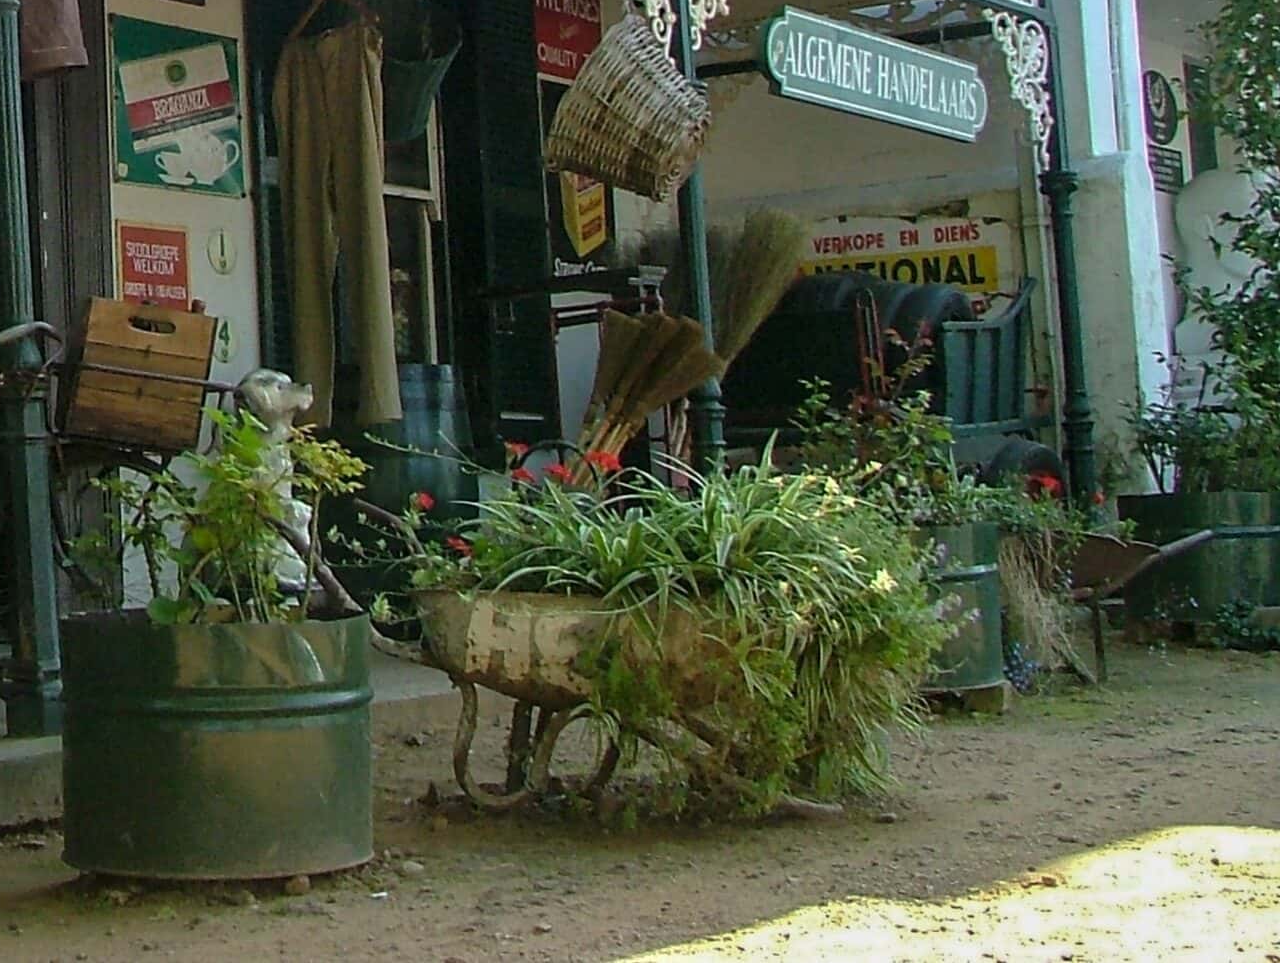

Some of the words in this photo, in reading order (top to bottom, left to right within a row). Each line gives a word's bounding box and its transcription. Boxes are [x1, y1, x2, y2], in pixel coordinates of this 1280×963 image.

[537, 42, 577, 69] QUALITY
[783, 31, 872, 95] ALGEMENE
[877, 54, 977, 121] HANDELAARS
[152, 87, 211, 121] BRAGANZA
[813, 232, 885, 255] VERKOPE
[900, 229, 919, 247] EN
[133, 257, 175, 276] WELKOM
[814, 253, 986, 286] IONAL
